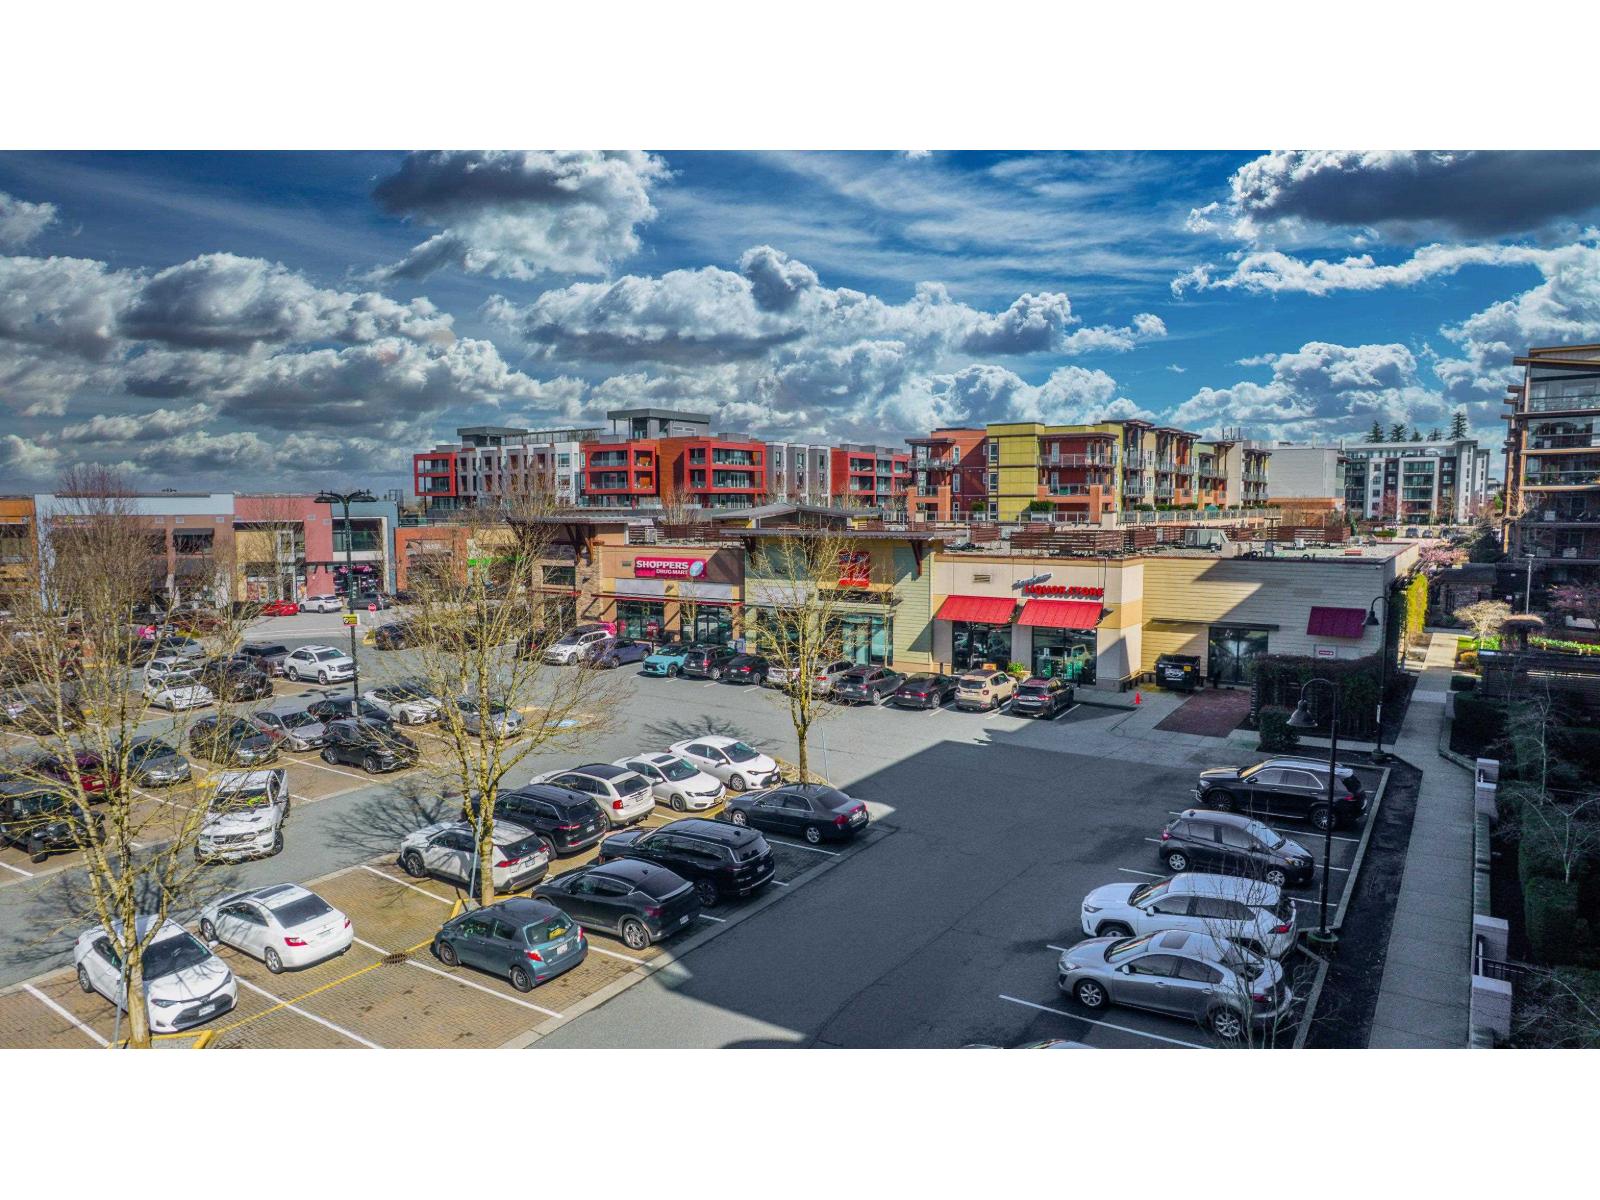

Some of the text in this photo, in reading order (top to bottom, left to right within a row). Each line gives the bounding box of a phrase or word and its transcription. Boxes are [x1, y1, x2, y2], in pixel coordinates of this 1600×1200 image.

[636, 560, 689, 570] SHOPPERS
[1025, 584, 1104, 596] LIQUOR STORE
